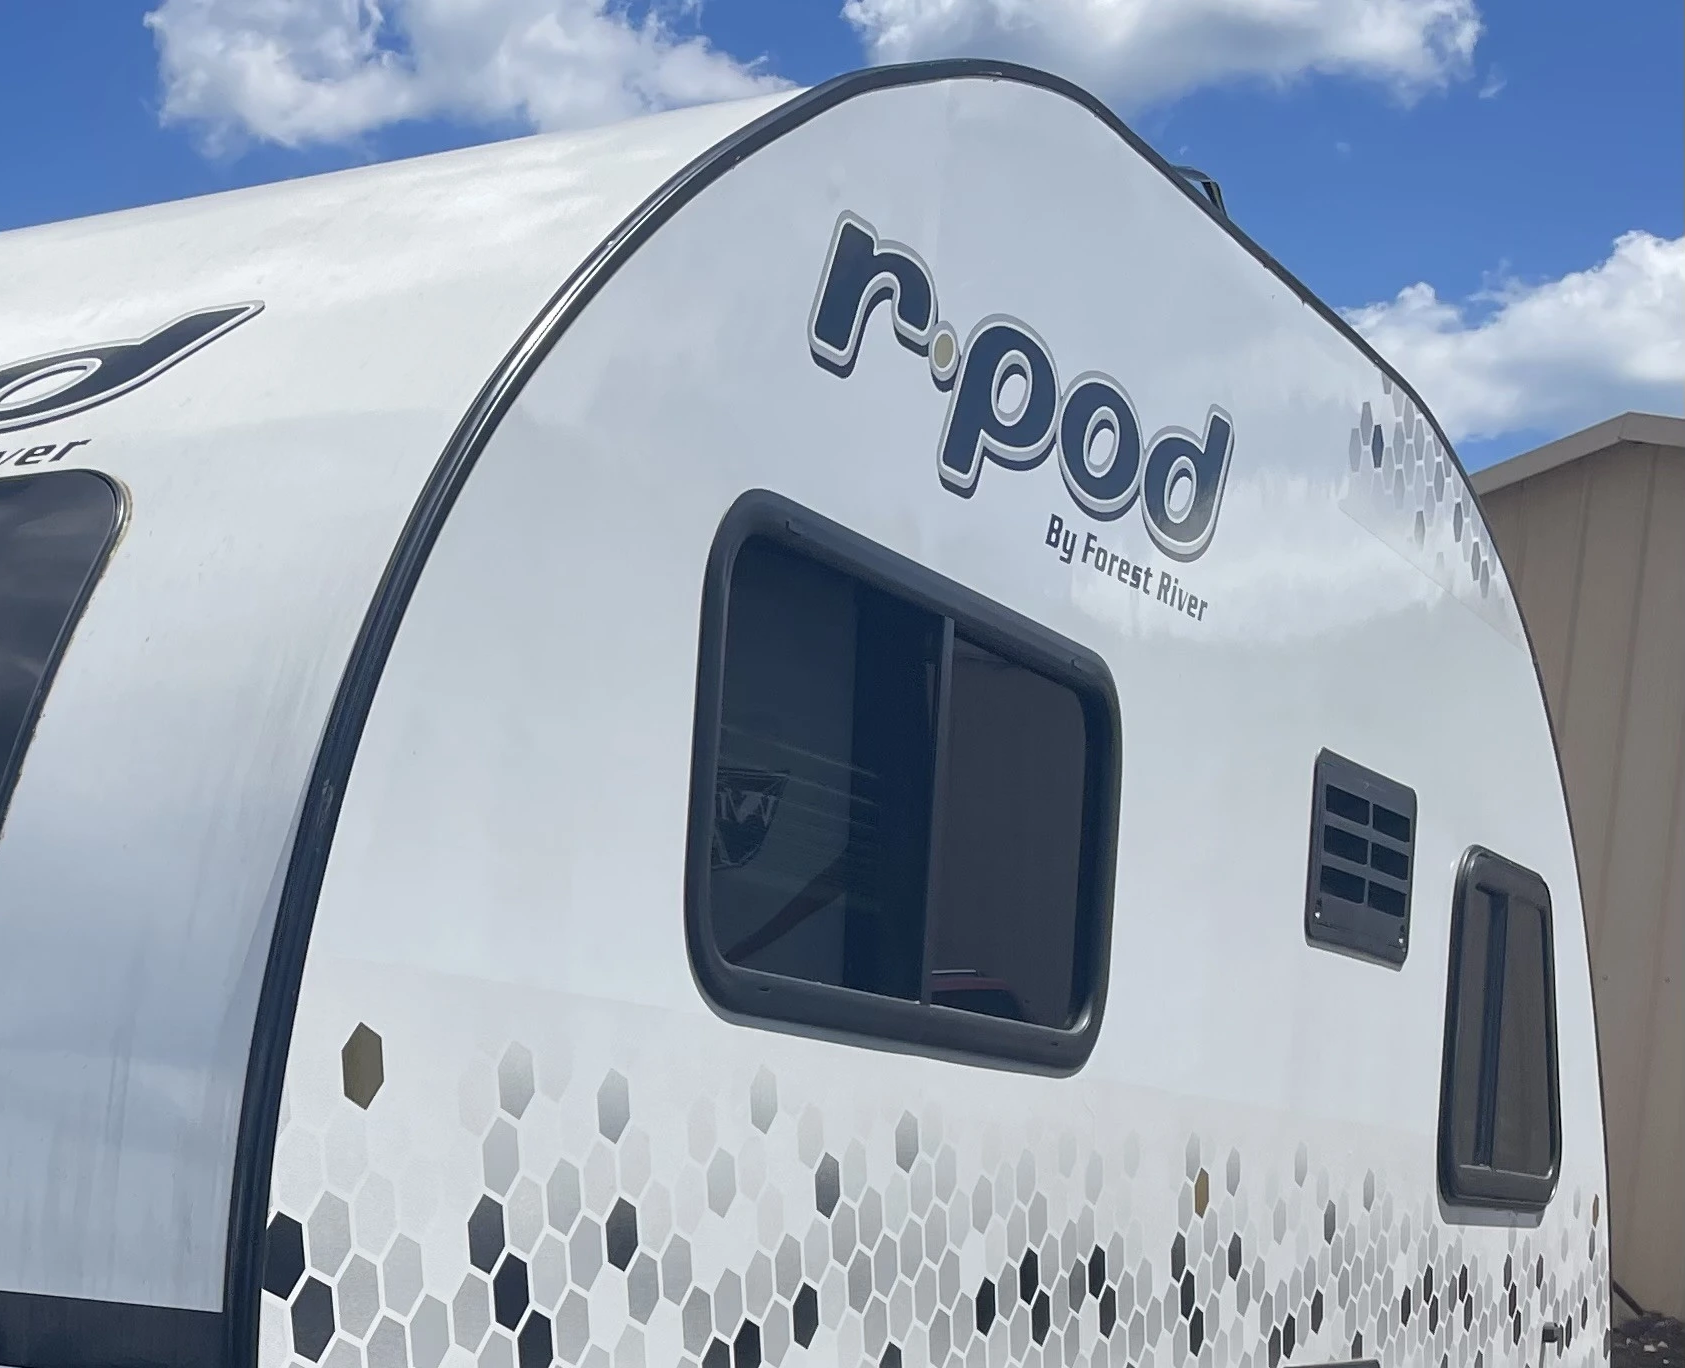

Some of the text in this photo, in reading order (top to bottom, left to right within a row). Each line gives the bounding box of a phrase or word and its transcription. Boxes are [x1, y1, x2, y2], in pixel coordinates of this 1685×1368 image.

[1045, 513, 1208, 622] By Forest River
